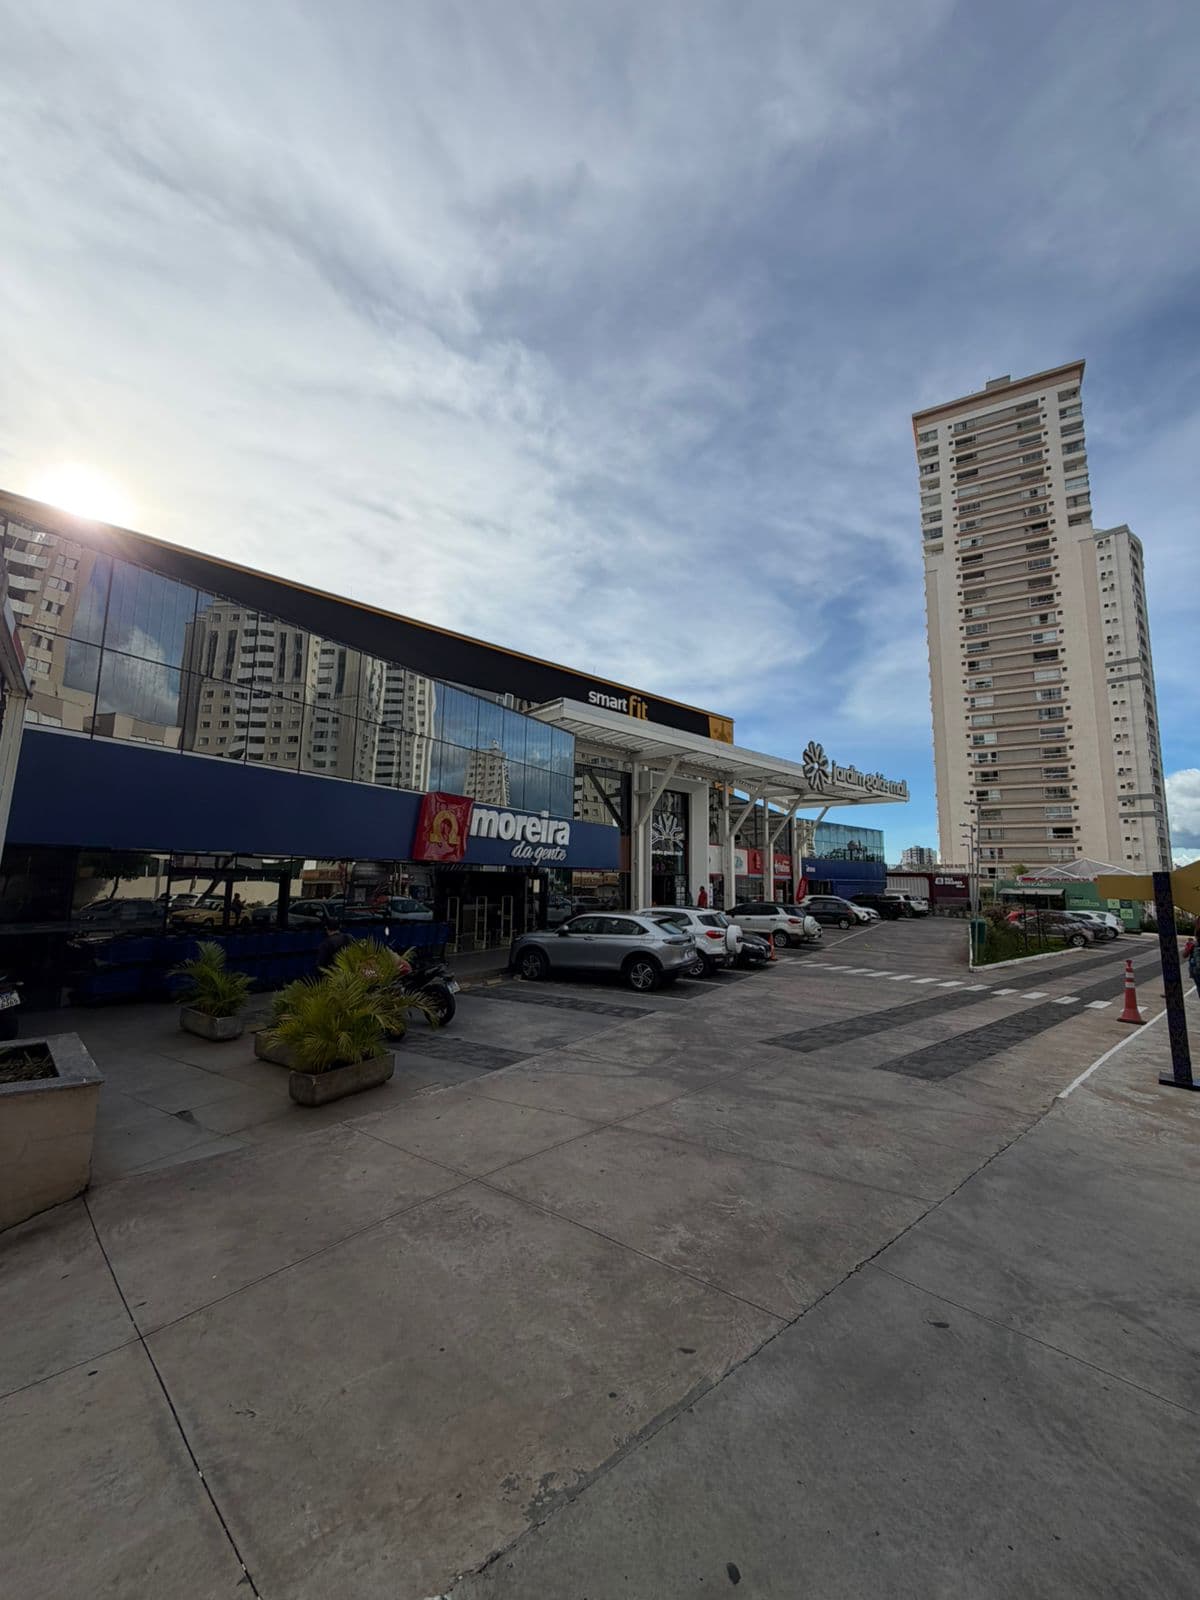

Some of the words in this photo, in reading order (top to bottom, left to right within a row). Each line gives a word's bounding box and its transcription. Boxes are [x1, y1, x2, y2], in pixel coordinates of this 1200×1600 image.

[588, 690, 628, 712] smart
[629, 695, 648, 720] fit
[832, 760, 864, 786] jardim
[470, 809, 570, 845] moreira
[511, 841, 532, 858] da
[534, 846, 567, 865] gente
